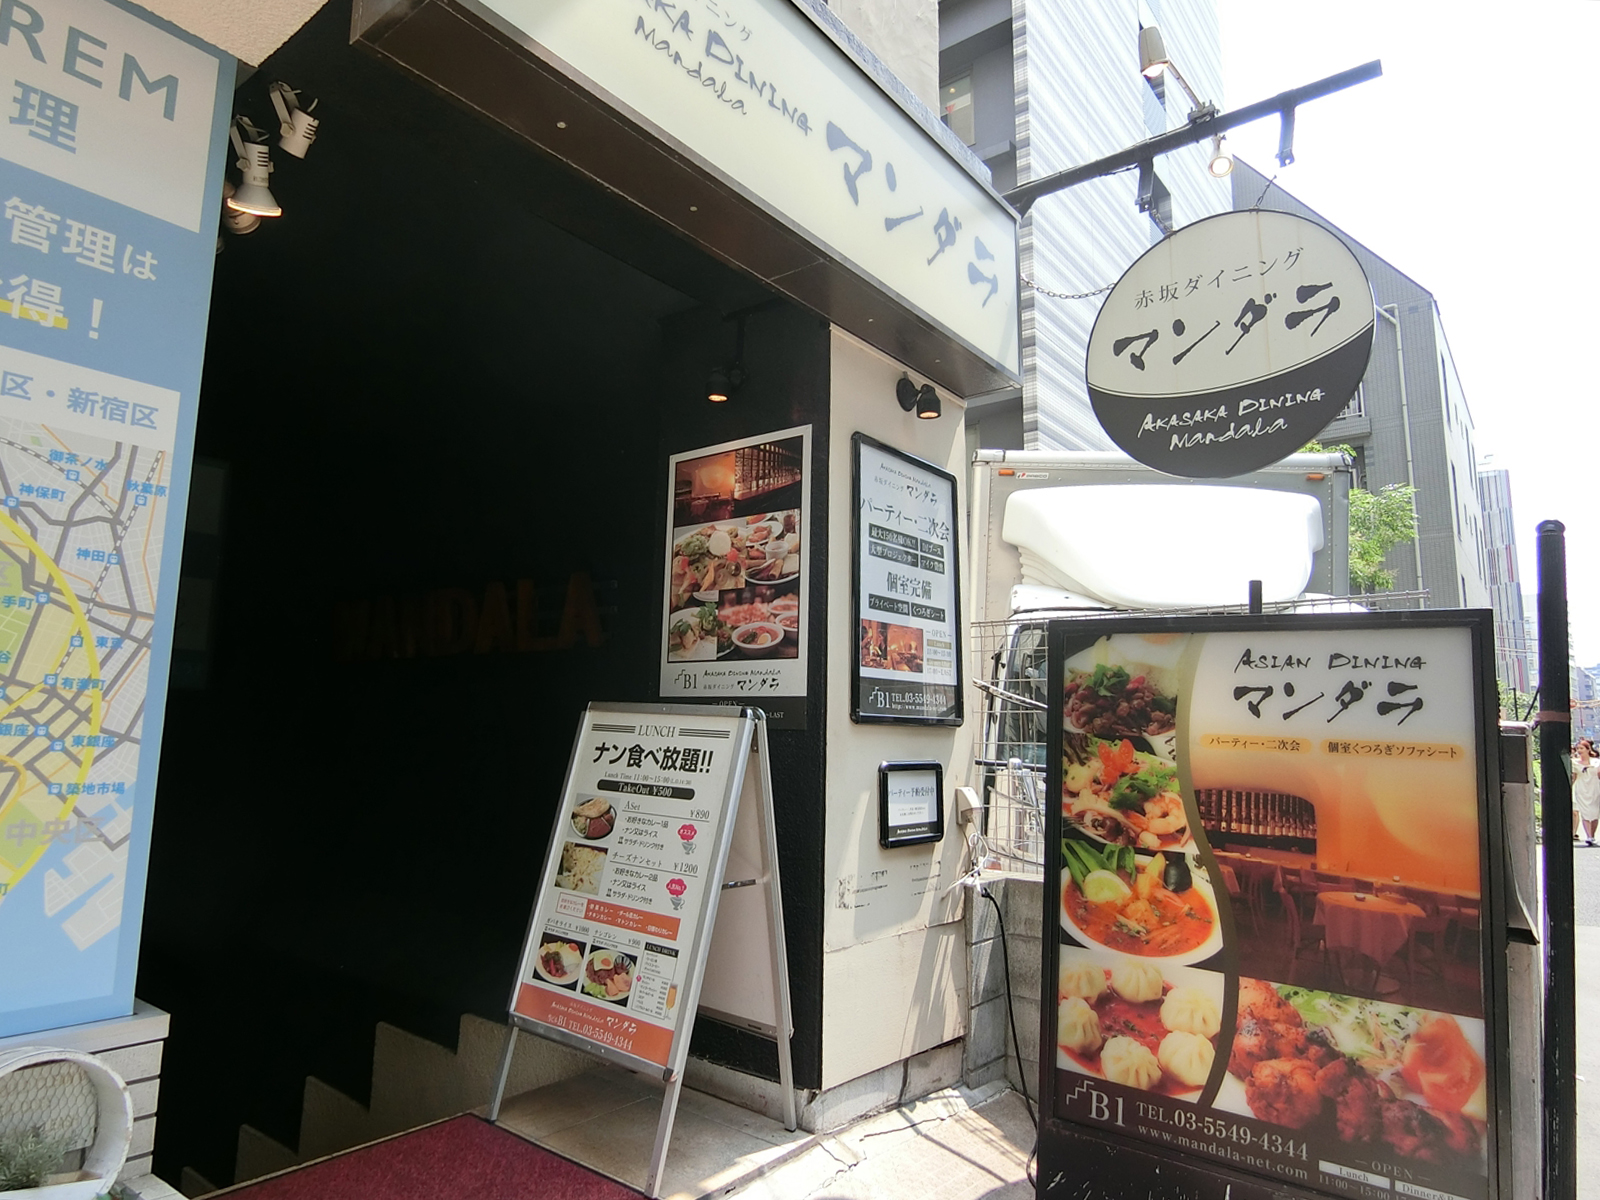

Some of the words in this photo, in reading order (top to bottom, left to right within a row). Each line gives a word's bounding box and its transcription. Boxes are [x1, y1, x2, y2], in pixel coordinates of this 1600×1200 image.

[0, 0, 180, 122] REM
[634, 15, 747, 116] Mandala
[645, 0, 693, 42] KA
[705, 29, 813, 137] DINING
[9, 79, 79, 154] 理
[826, 120, 999, 309] マンダラ
[5, 196, 158, 281] 管理は
[1134, 246, 1304, 311] 赤坂ダイニング
[0, 273, 104, 339] 得！
[1113, 281, 1341, 371] マンダラ
[1137, 404, 1228, 438] AKASAKA
[1238, 387, 1326, 414] DINING
[1169, 416, 1288, 451] Mandala
[49, 448, 110, 471] 御茶ノ水
[19, 482, 66, 502] 神保町
[126, 479, 168, 498] 秋葉原
[907, 484, 937, 506] マンダラ
[76, 547, 105, 562] 神田
[886, 571, 932, 600] 個室完備
[869, 596, 909, 614] プライベート空間
[912, 605, 944, 620] くつろぎシート
[95, 635, 124, 650] 東京
[1234, 648, 1311, 673] ASIAN
[1328, 653, 1427, 671] DINING
[61, 677, 107, 692] 有楽町
[683, 673, 698, 690] B1
[737, 677, 780, 692] マンダラ
[877, 691, 890, 708] B1
[1233, 680, 1424, 726] マンダラ
[0, 723, 30, 737] 銀座
[71, 734, 115, 749] 東銀座
[637, 724, 677, 738] LUNCH
[593, 741, 714, 774] ナン食べ放題!!
[1209, 737, 1301, 752] パーティー・二次会
[1327, 741, 1458, 759] 個室くつろぎソファシート
[66, 781, 125, 796] 築地市場
[618, 782, 650, 795] TakeOut
[653, 786, 673, 797] ¥500
[689, 809, 710, 820] ¥890
[6, 816, 106, 847] 中央区
[612, 851, 662, 867] チーズナンセット
[674, 862, 698, 874] ¥1200
[568, 1019, 634, 1051] TEL.03-5549-4344
[606, 1015, 637, 1036] マンダラ
[1088, 1089, 1126, 1128] B1
[1136, 1101, 1309, 1161] TEL.03-5549-4344
[1138, 1124, 1309, 1181] www.mandala-net.com
[1338, 1167, 1369, 1182] Lunch
[1371, 1160, 1414, 1180] OPEN
